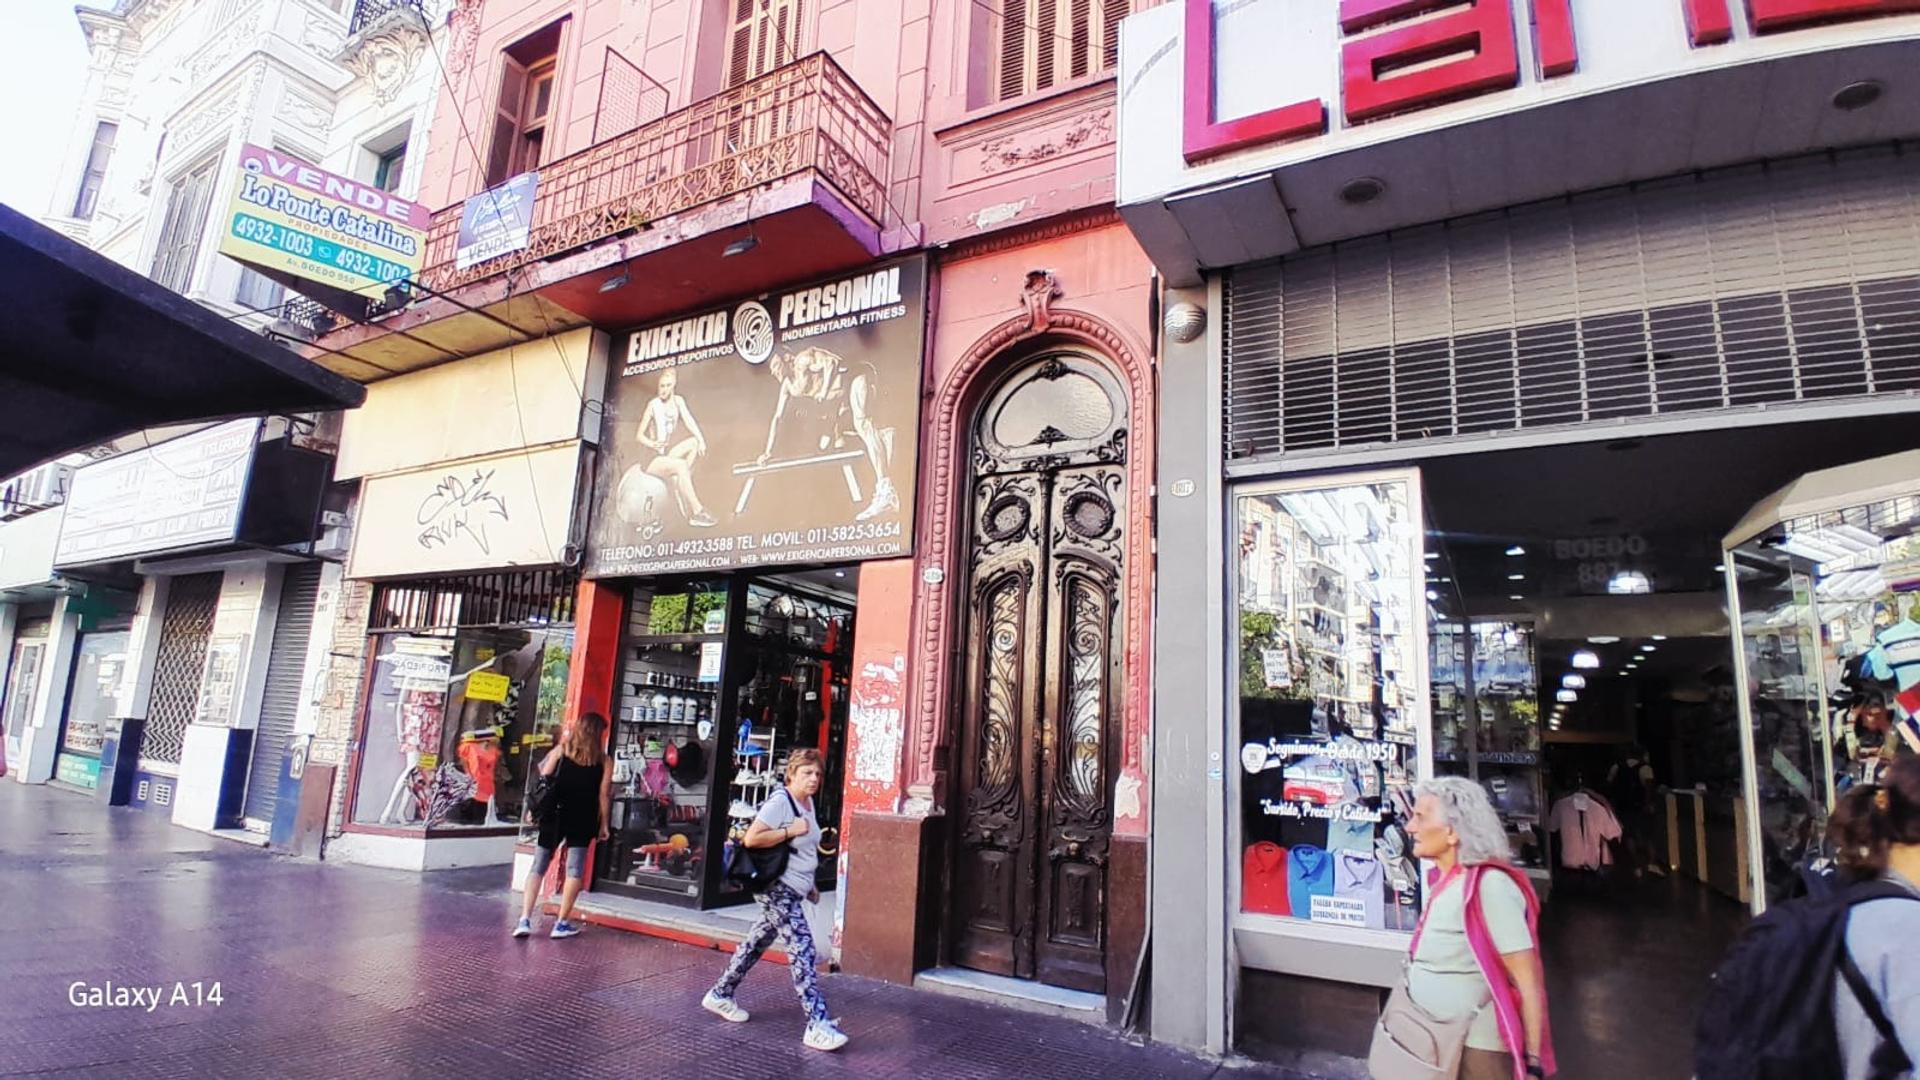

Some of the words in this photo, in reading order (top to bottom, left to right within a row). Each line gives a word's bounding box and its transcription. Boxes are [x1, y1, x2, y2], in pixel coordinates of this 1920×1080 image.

[265, 153, 410, 221] VENDE
[235, 216, 314, 257] 4932-1003
[287, 218, 369, 251] PROPIEDADES
[331, 206, 416, 256] Catalina
[468, 236, 513, 260] VENDE
[779, 267, 902, 330] PERSONAL
[627, 311, 728, 364] EXIGENCIA
[781, 316, 858, 342] INDUMENTARIA
[860, 304, 906, 326] FITNESS
[622, 357, 677, 377] ACCESORIOS
[678, 343, 735, 367] DEPORTIVOS
[601, 545, 656, 561] TELEFONO:
[657, 537, 734, 557] 011-4932-3588
[760, 531, 804, 548] MOVIL:
[807, 521, 901, 544] 011-5825-3654
[1554, 536, 1647, 560] BOEDO
[1365, 743, 1398, 761] 1950
